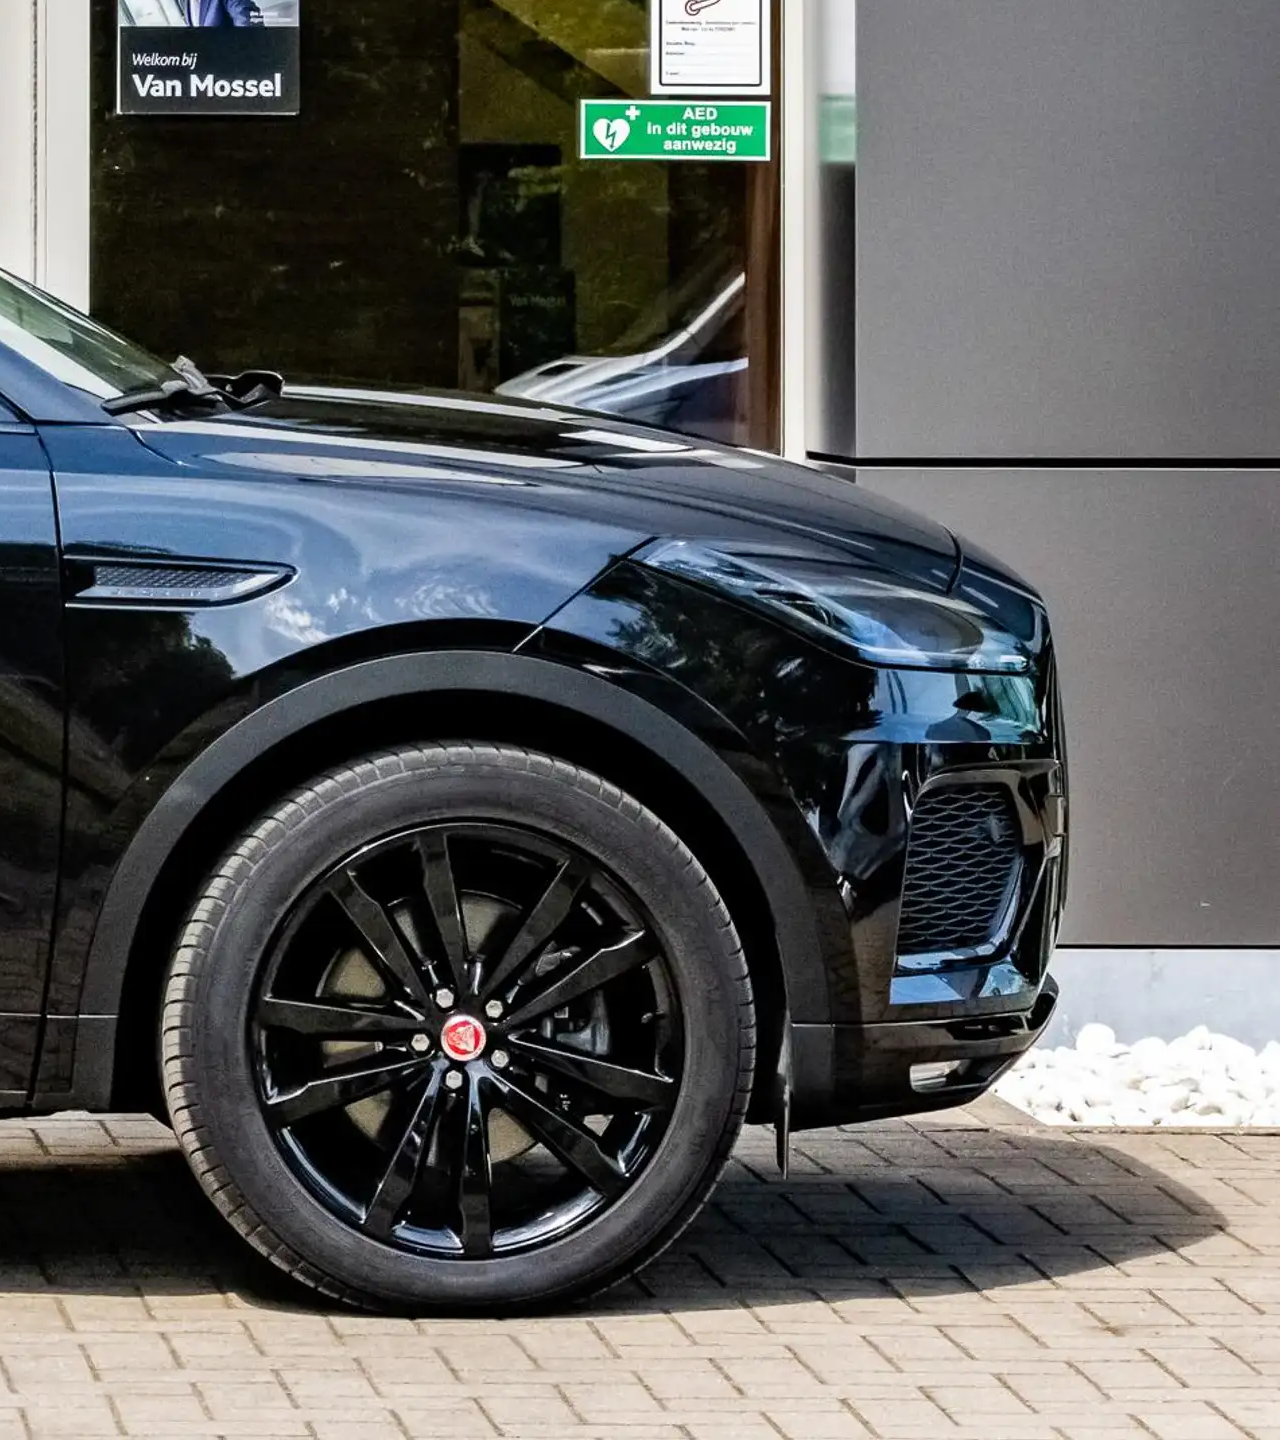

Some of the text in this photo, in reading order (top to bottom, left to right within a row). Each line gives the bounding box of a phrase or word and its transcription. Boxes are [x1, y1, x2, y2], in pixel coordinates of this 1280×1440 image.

[132, 52, 198, 70] Welkom bij
[131, 72, 282, 98] Van Mossel
[682, 106, 718, 121] AED
[666, 122, 687, 136] dit
[691, 122, 754, 138] gebouw
[663, 139, 737, 154] aanwezig
